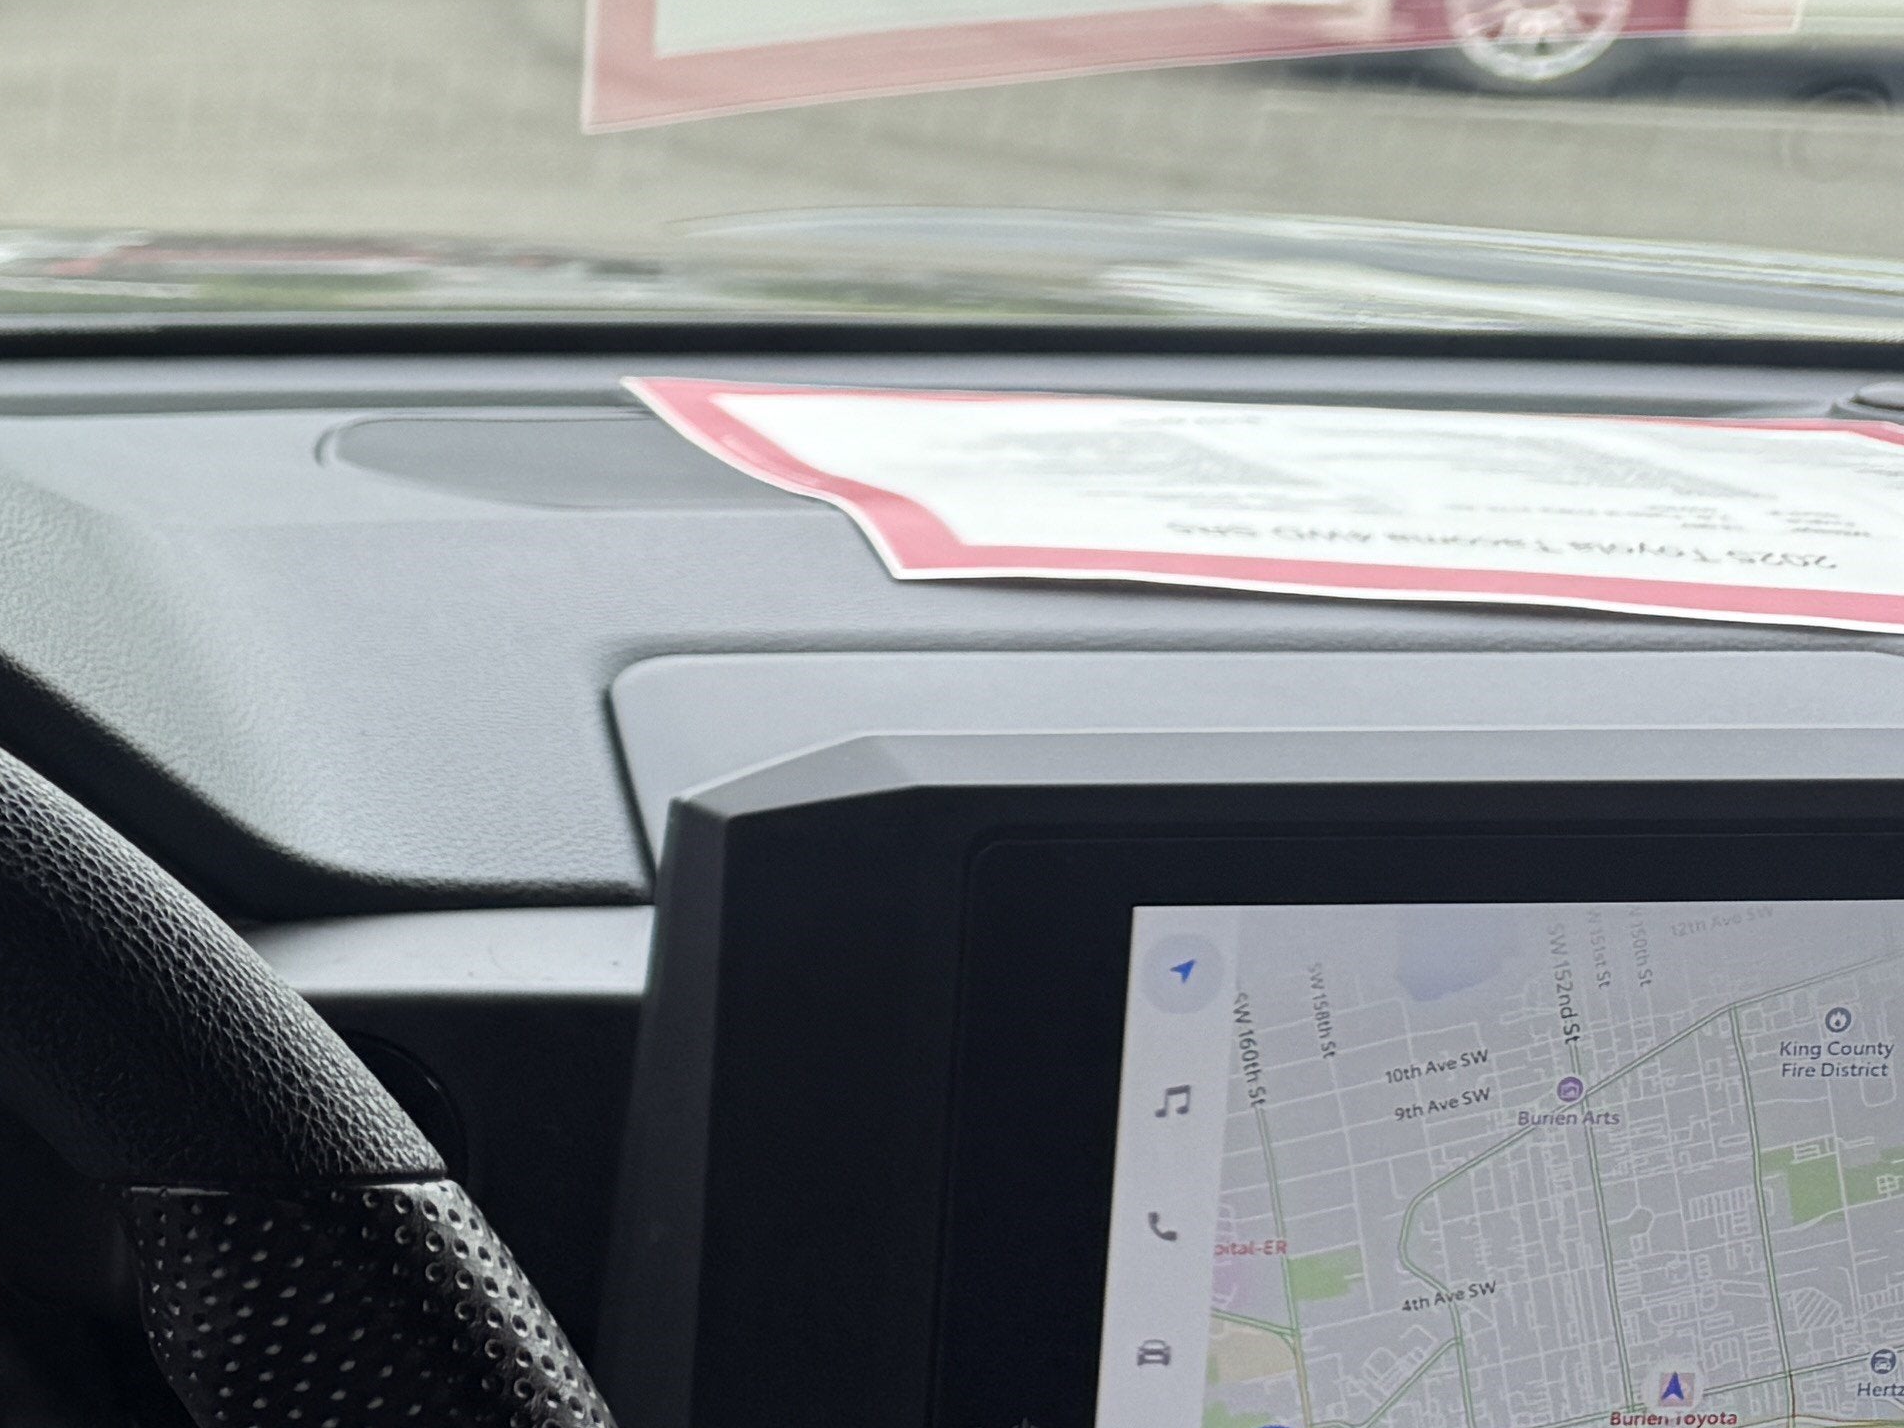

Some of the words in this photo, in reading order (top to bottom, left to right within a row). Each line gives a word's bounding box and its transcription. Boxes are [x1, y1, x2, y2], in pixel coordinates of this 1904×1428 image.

[1547, 924, 1568, 956] SW
[1553, 960, 1580, 1020] 152nd
[1311, 991, 1334, 1040] 158th
[1562, 1022, 1582, 1045] St
[1238, 1027, 1263, 1083] 160th
[1321, 1042, 1337, 1060] St
[1779, 1041, 1822, 1060] King
[1827, 1041, 1896, 1060] County
[1384, 1063, 1422, 1085] 10th
[1424, 1056, 1458, 1076] Ave
[1459, 1048, 1490, 1069] SW
[1781, 1062, 1818, 1078] Fire
[1821, 1062, 1889, 1078] District
[1247, 1086, 1267, 1109] St
[1394, 1103, 1424, 1122] 9th
[1426, 1095, 1460, 1113] Ave
[1461, 1086, 1492, 1107] SW
[1517, 1110, 1580, 1126] Burien
[1583, 1110, 1621, 1126] Arts
[1401, 1297, 1431, 1313] 4th
[1433, 1289, 1466, 1306] Ave
[1467, 1280, 1498, 1298] SW
[1857, 1382, 1904, 1397] Hertz
[1609, 1411, 1670, 1427] Burien
